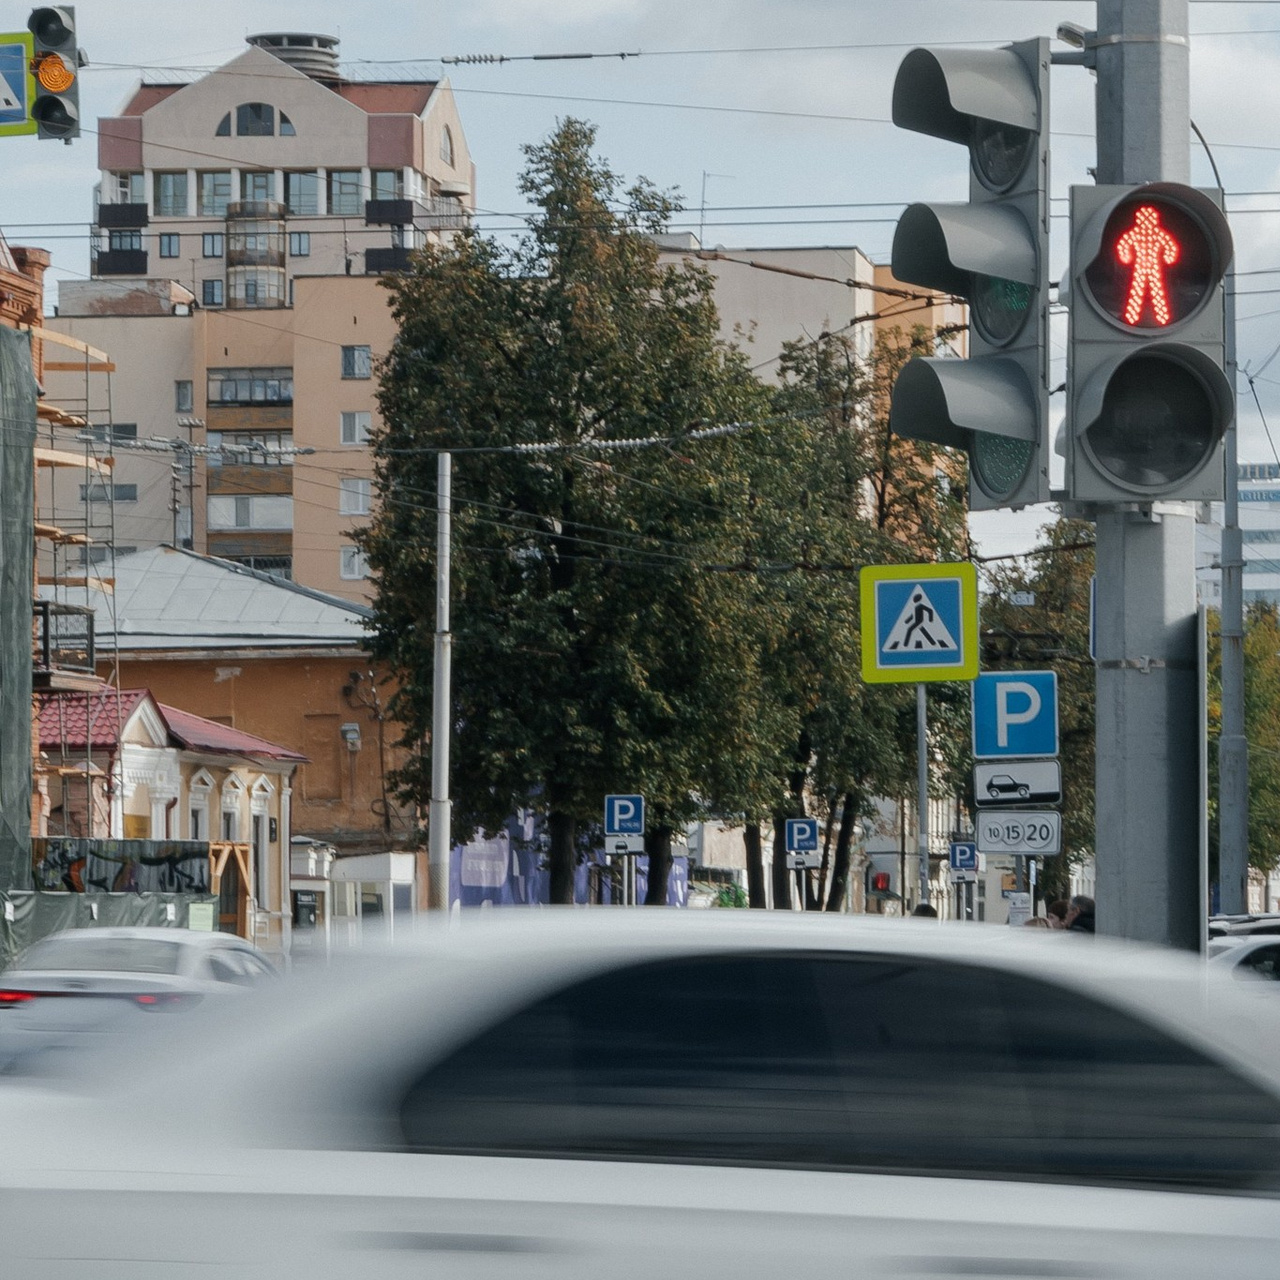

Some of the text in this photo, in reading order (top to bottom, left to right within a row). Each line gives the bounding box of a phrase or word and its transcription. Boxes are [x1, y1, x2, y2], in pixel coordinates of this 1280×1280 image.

[995, 681, 1042, 748] P
[614, 799, 635, 831] P
[793, 823, 811, 849] P
[988, 824, 1050, 841] 10 15 20
[955, 845, 971, 867] P
